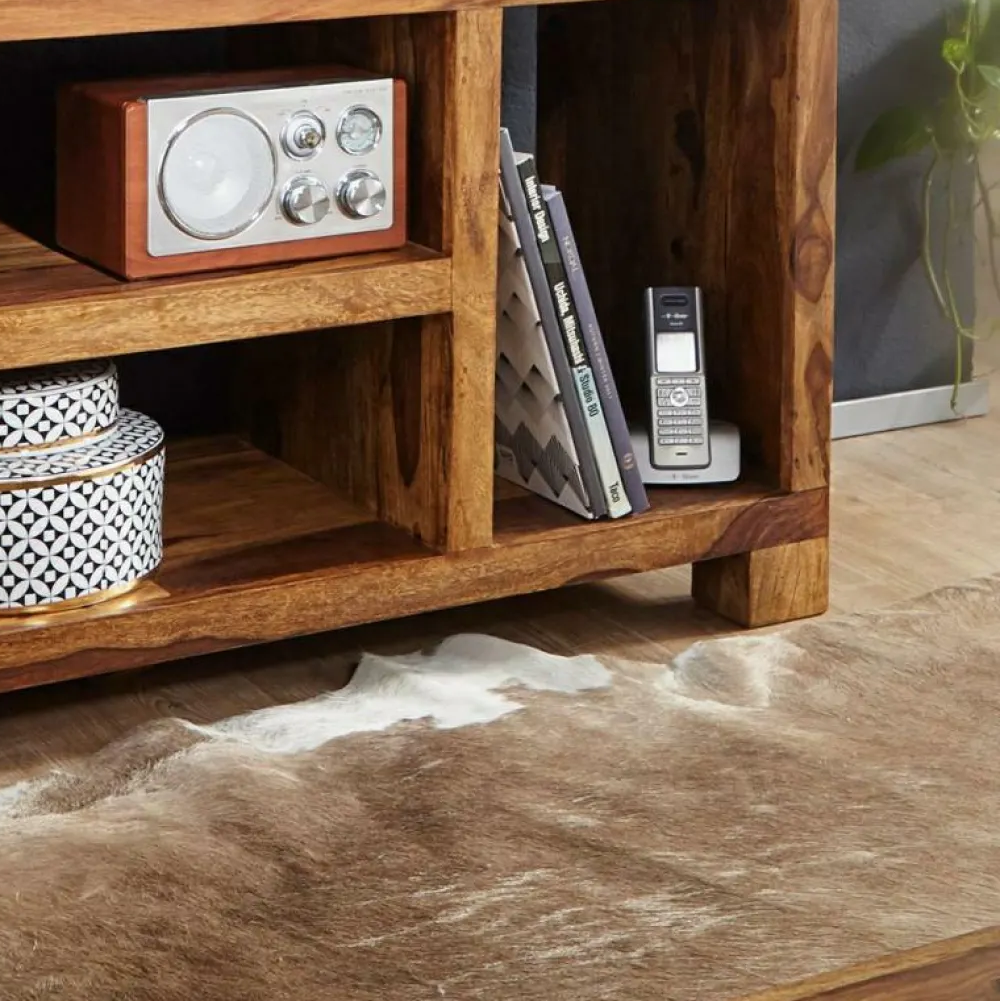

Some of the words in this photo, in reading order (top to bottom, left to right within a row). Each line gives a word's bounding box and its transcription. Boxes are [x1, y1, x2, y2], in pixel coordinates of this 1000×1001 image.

[524, 176, 540, 209] Interior
[534, 209, 549, 242] Design
[579, 373, 595, 403] Studio
